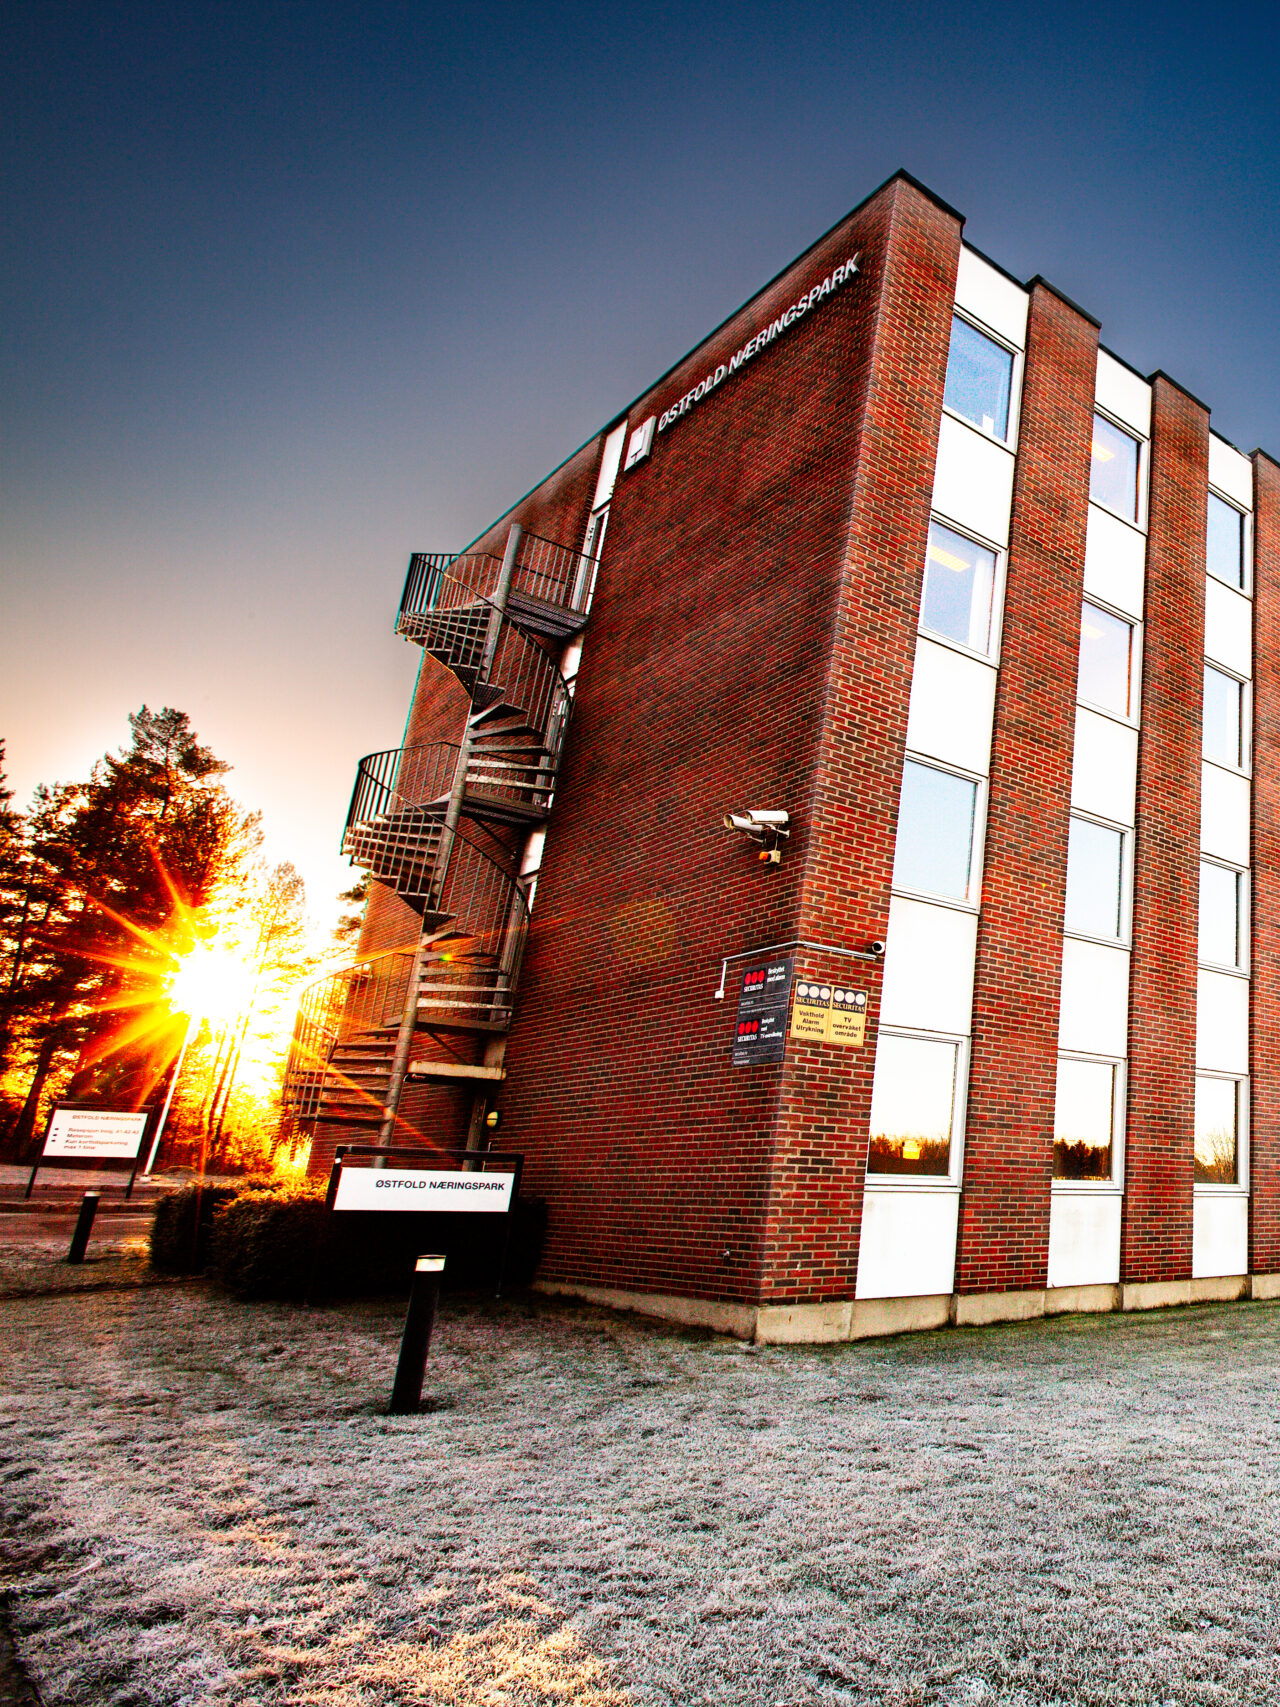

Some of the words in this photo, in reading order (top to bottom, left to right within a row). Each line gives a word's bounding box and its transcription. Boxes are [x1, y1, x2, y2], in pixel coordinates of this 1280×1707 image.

[657, 364, 728, 434] ØSTFOLD
[728, 251, 860, 375] NÆRINGSPARK
[743, 983, 763, 992] SECURITAS
[796, 996, 830, 1007] SECURITAS
[832, 1002, 865, 1012] SECURITAS
[799, 1010, 824, 1019] Vakthold
[796, 1024, 825, 1034] Utrykning
[835, 1030, 858, 1038] område
[737, 1034, 758, 1043] SECURITAS
[375, 1180, 426, 1189] ØSTFOLD
[428, 1181, 505, 1191] NÆRINGSPARK
